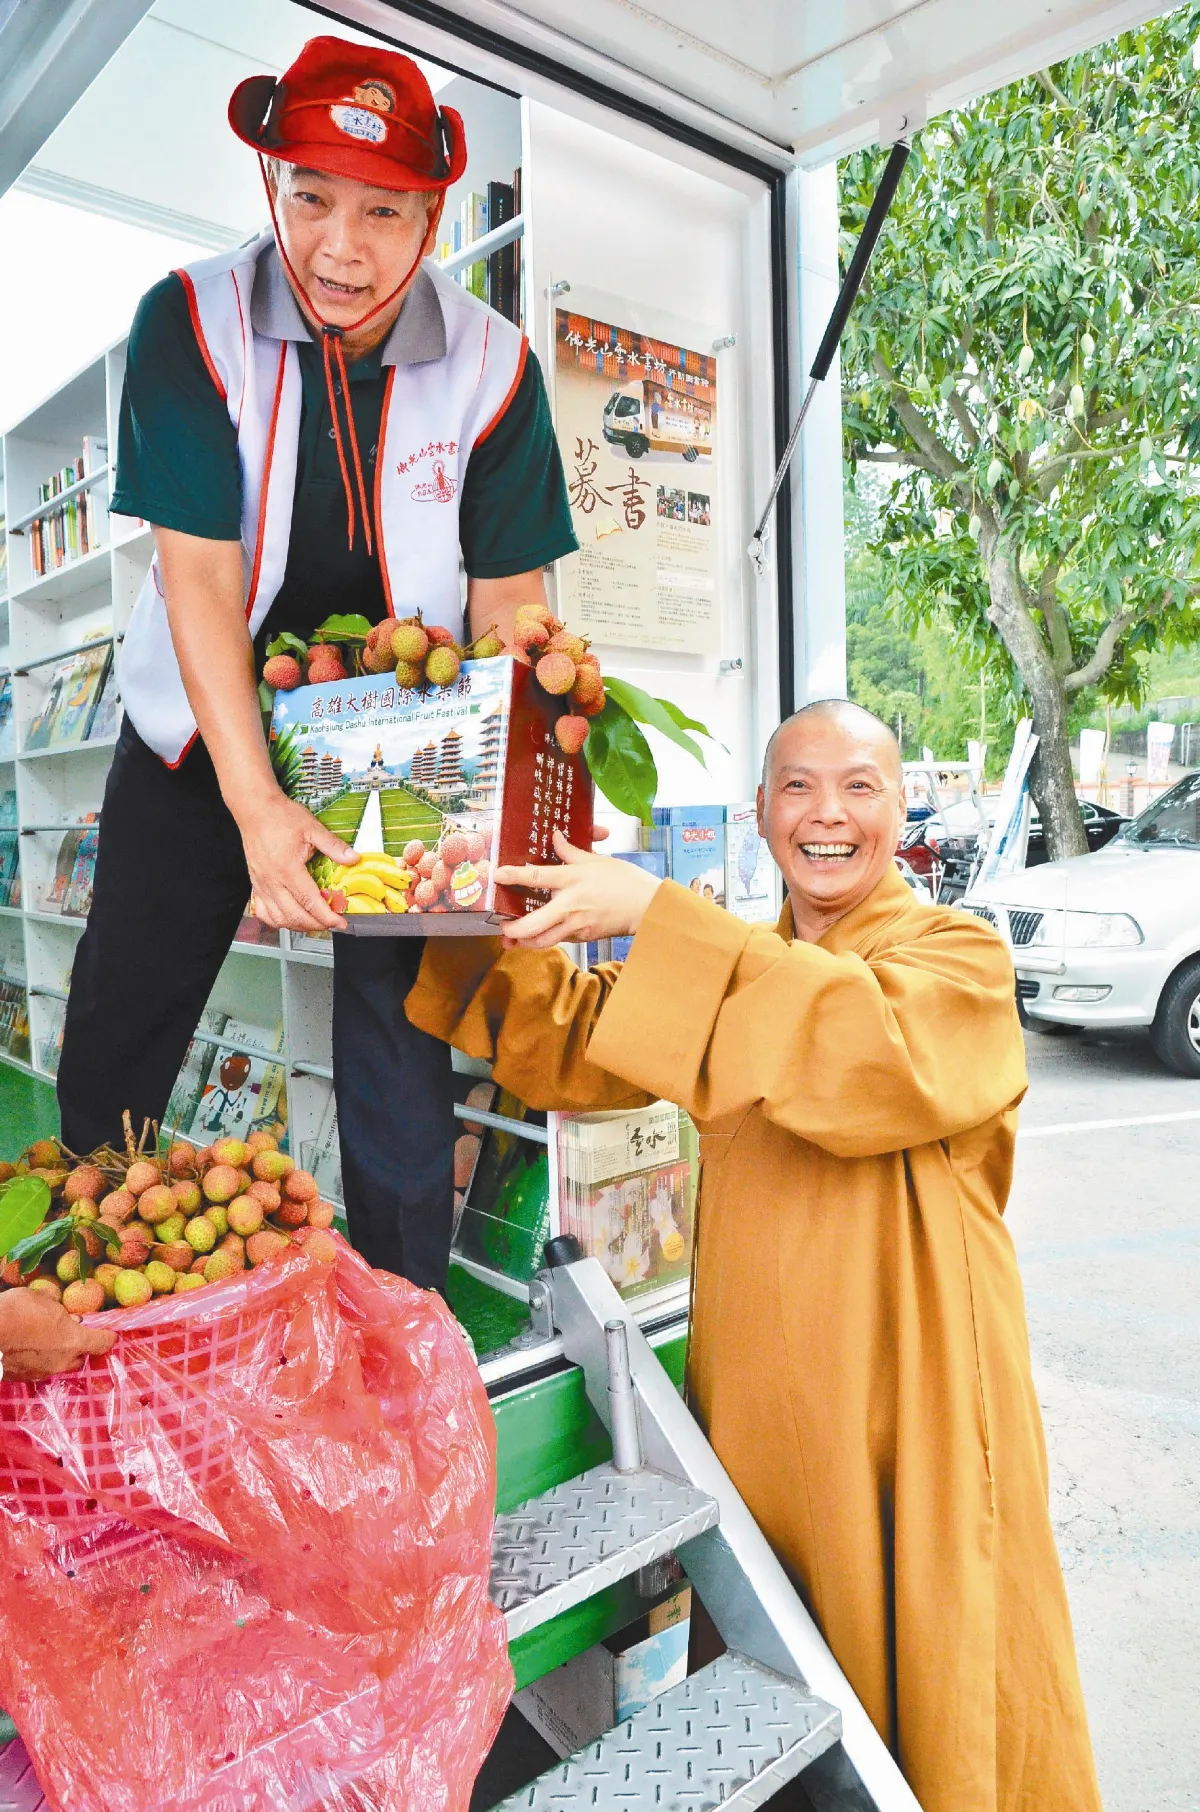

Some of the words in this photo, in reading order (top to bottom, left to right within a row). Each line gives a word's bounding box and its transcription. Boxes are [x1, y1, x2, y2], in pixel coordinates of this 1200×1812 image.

[565, 329, 667, 375] 佛光山雲水書坊
[397, 441, 460, 475] 佛光山雲水書
[568, 437, 651, 529] 募書
[311, 675, 472, 718] 高雄大樹國際水果節
[310, 724, 343, 734] Kaohsiung
[345, 719, 366, 729] Dashu
[369, 712, 414, 726] International
[415, 710, 434, 721] Fruit
[436, 706, 468, 718] Festival
